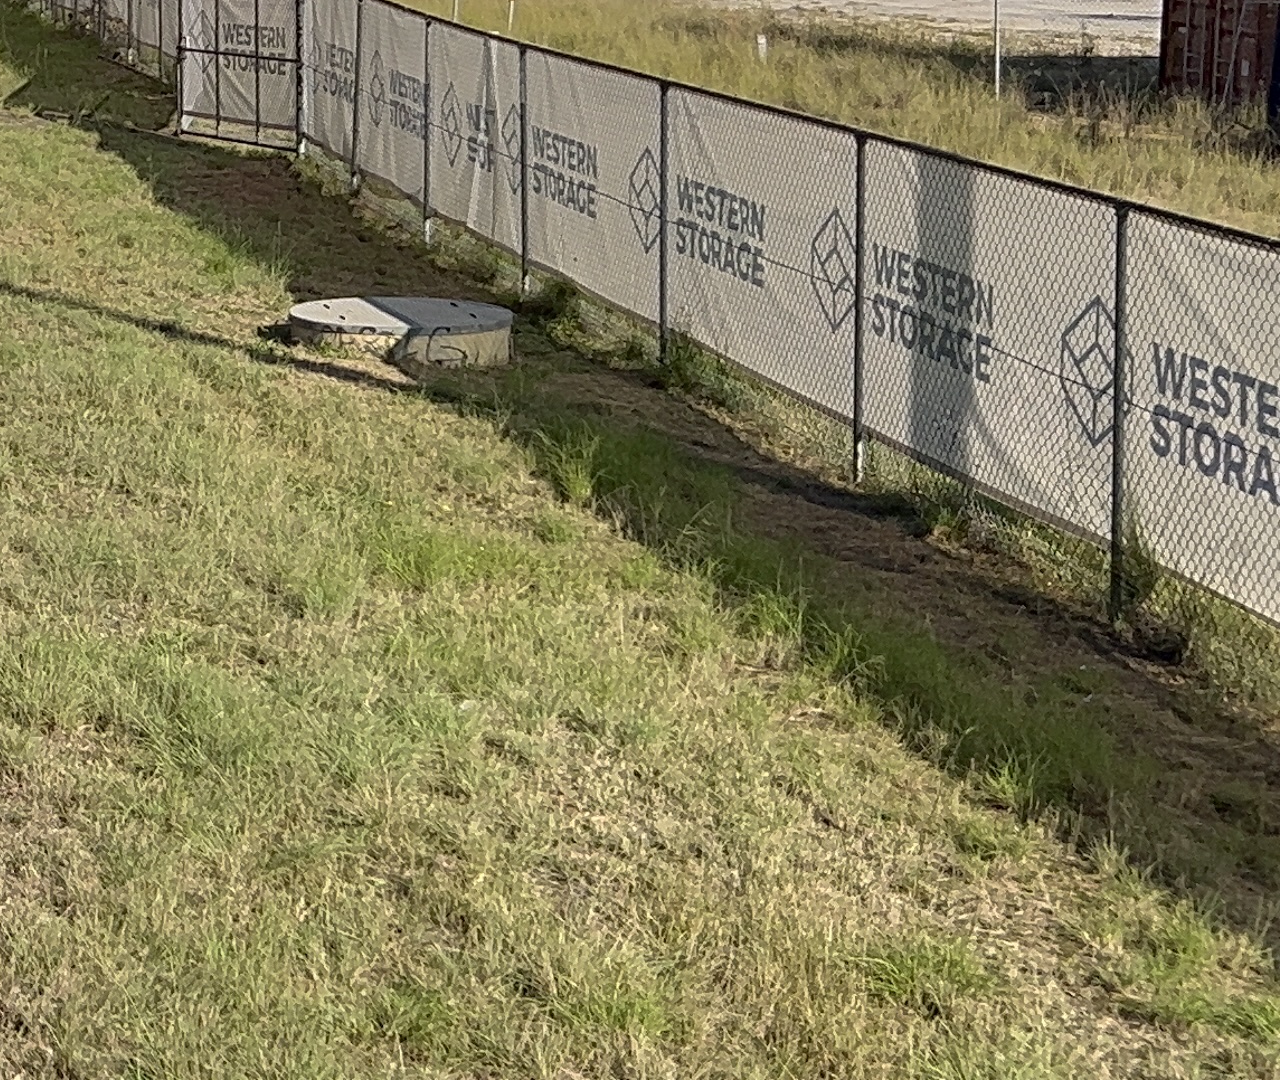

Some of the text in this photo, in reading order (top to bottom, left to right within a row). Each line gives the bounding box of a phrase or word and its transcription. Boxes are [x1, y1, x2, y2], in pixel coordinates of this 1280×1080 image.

[532, 125, 598, 179] WESTERN
[533, 162, 598, 219] STORAGE
[677, 174, 765, 242] WESTERN
[676, 217, 765, 287] STORAGE
[873, 243, 994, 330] WESTERN
[872, 293, 992, 382] STORAGE
[1149, 341, 1280, 438] WESTE
[1149, 404, 1280, 506] STORA
